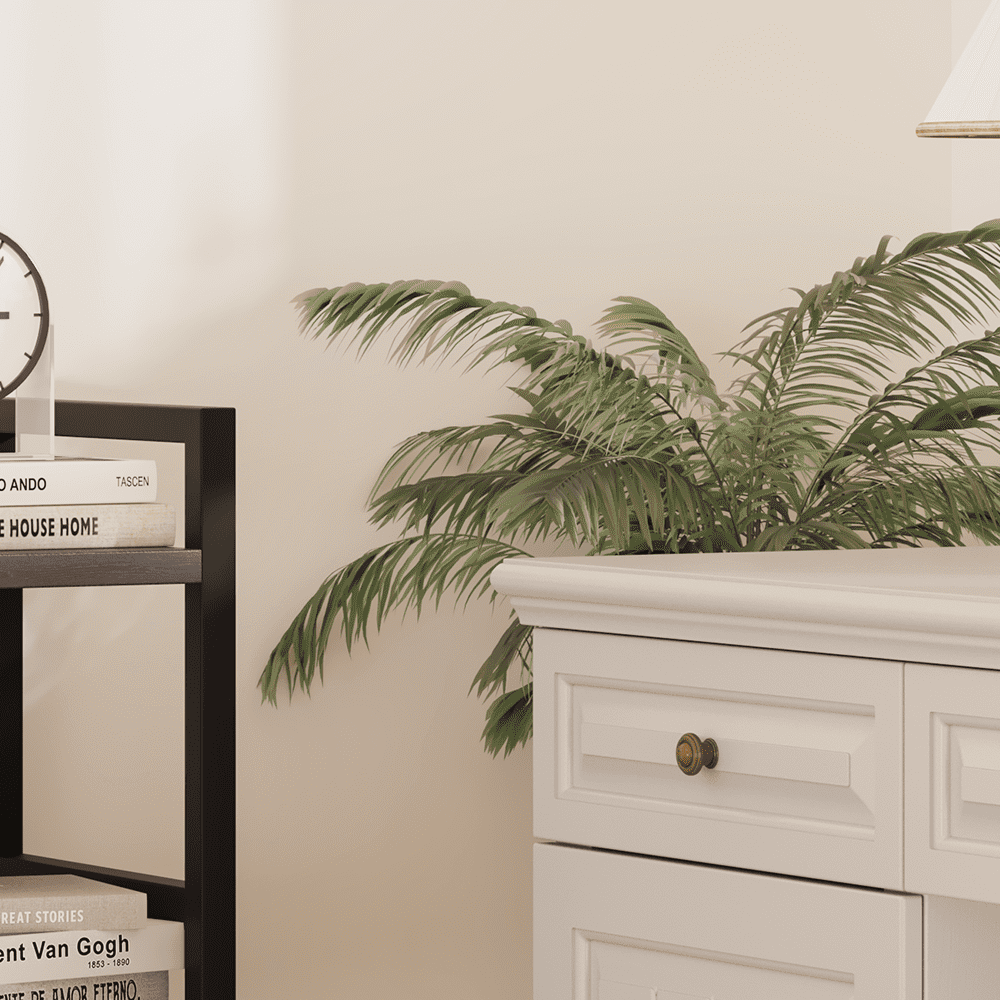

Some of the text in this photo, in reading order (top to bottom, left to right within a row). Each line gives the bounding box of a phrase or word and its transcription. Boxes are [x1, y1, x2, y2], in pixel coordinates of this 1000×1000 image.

[10, 477, 47, 492] ANDO
[116, 476, 150, 488] TASCEN
[10, 518, 55, 537] HOUSE
[59, 517, 99, 537] HOME
[35, 909, 84, 924] STORIES
[32, 940, 69, 960] Van
[76, 934, 130, 959] Gogh
[87, 959, 105, 969] 1853
[112, 957, 130, 968] 1890
